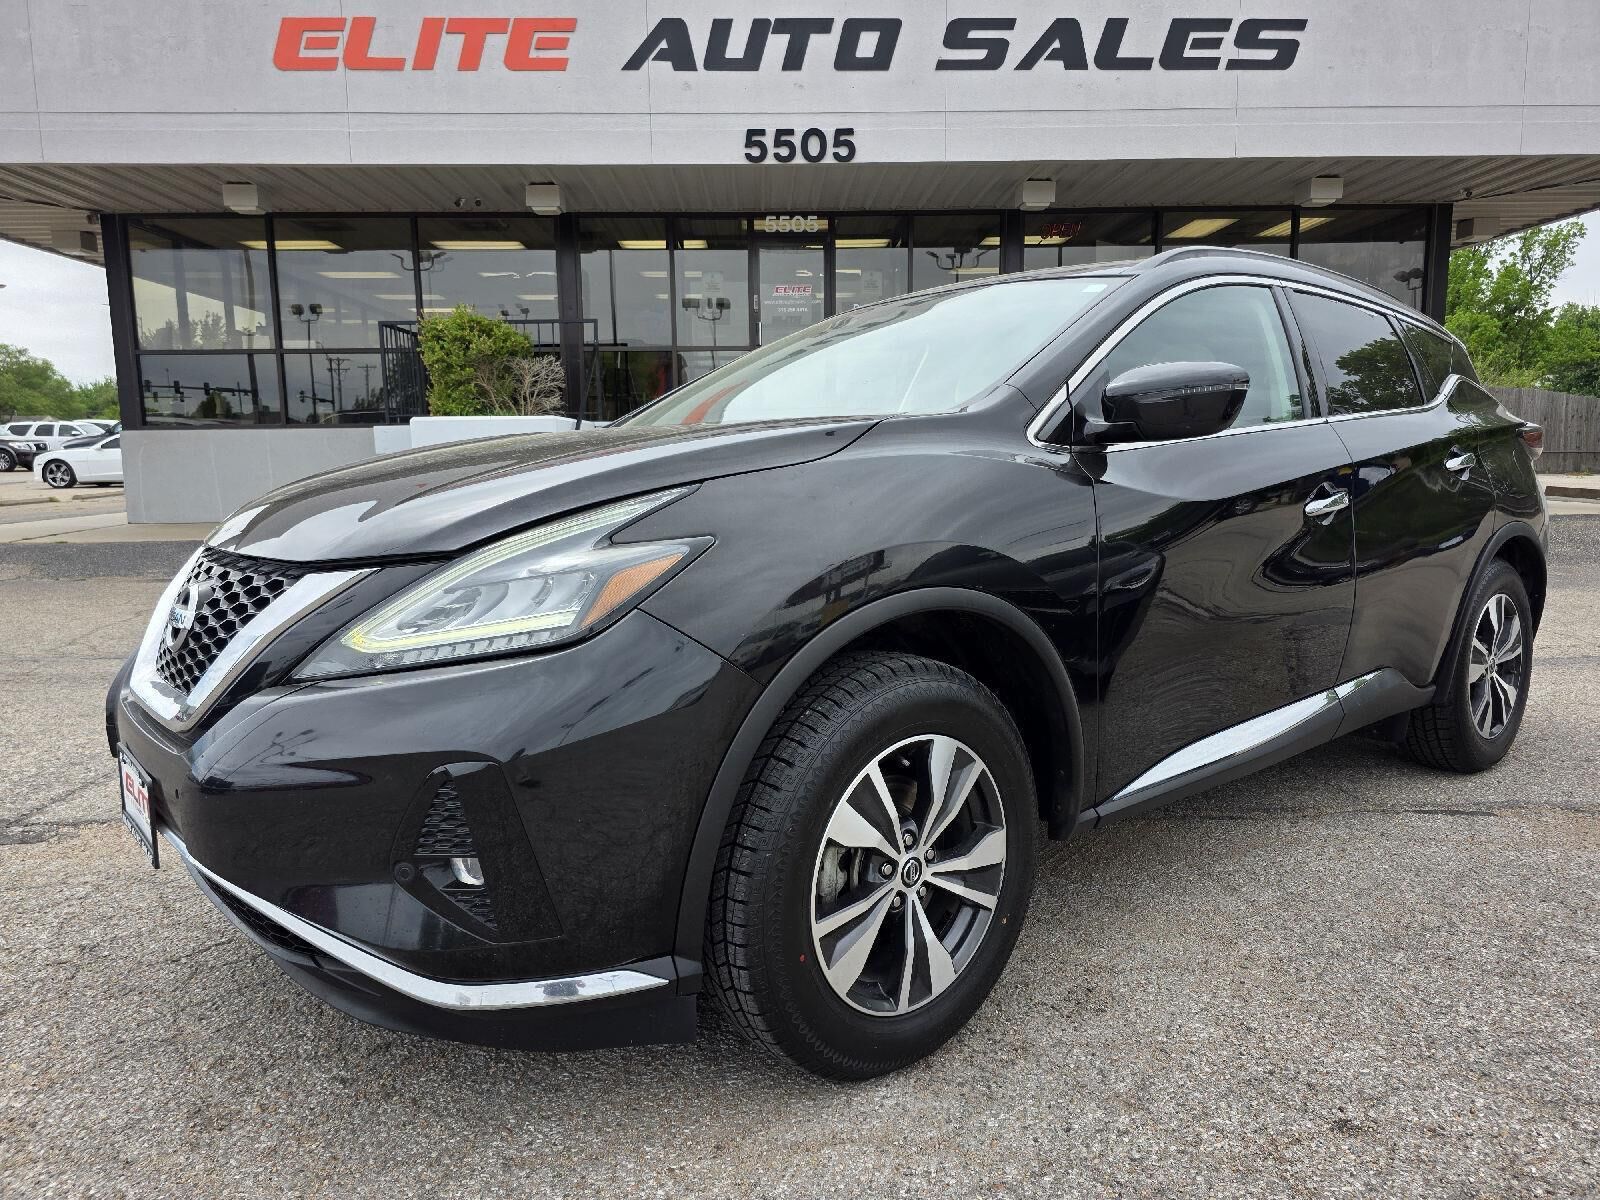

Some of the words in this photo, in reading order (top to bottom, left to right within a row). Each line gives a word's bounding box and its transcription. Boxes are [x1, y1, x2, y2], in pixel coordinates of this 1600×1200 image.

[274, 16, 577, 71] ELITE
[622, 17, 903, 71] AUTO
[936, 17, 1308, 71] SALES
[744, 128, 856, 163] 5505
[764, 215, 818, 232] 5505
[774, 285, 813, 294] ELITE
[125, 771, 151, 817] ELIT
